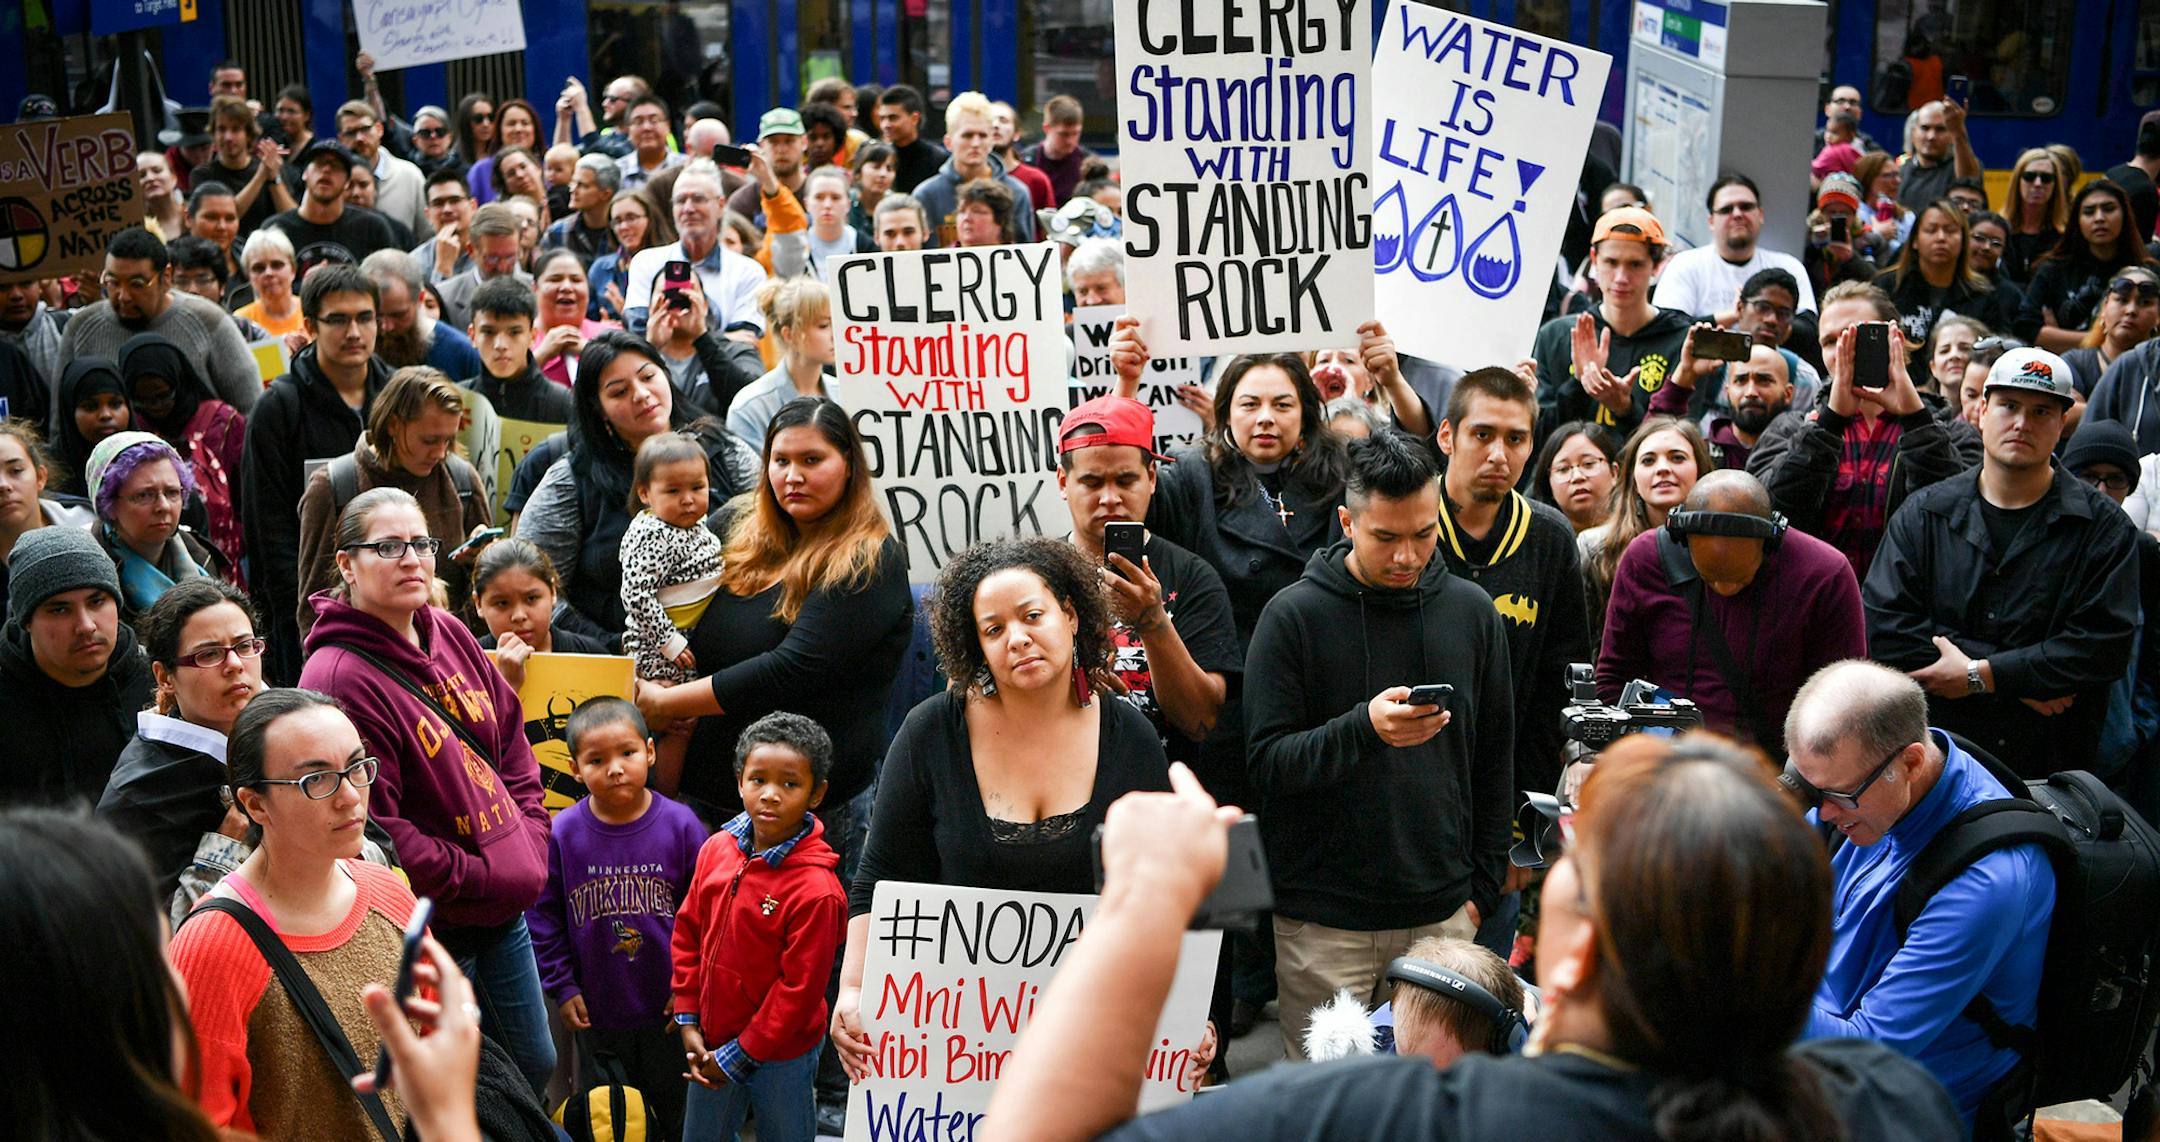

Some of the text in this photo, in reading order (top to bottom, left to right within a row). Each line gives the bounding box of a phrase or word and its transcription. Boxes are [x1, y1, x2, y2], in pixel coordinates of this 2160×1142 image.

[1138, 0, 1356, 57] CLERGY
[1401, 5, 1579, 106] WATER
[1127, 57, 1355, 169] Standing
[1440, 80, 1495, 136] IS
[16, 122, 138, 191] VERB
[16, 159, 33, 180] A
[1185, 146, 1290, 182] WITH
[50, 178, 133, 223] ACROSS
[73, 205, 122, 227] THE
[1125, 172, 1372, 258] STANDING
[838, 248, 1053, 324] CLERGY
[1175, 254, 1332, 340] ROCK
[1081, 321, 1114, 347] W
[844, 323, 1030, 403] Standing
[1079, 354, 1116, 377] Dri
[886, 379, 985, 412] WITH
[885, 480, 1044, 570] ROCK
[456, 798, 517, 835] NATI
[588, 863, 663, 874] MINNESOTA
[569, 874, 676, 928] VIKINGS
[880, 899, 1084, 967] #NODA
[876, 971, 1038, 1034] Mni Wi
[860, 1031, 928, 1080] Nibi
[946, 1034, 1013, 1084] Bim
[866, 1089, 987, 1142] Water
